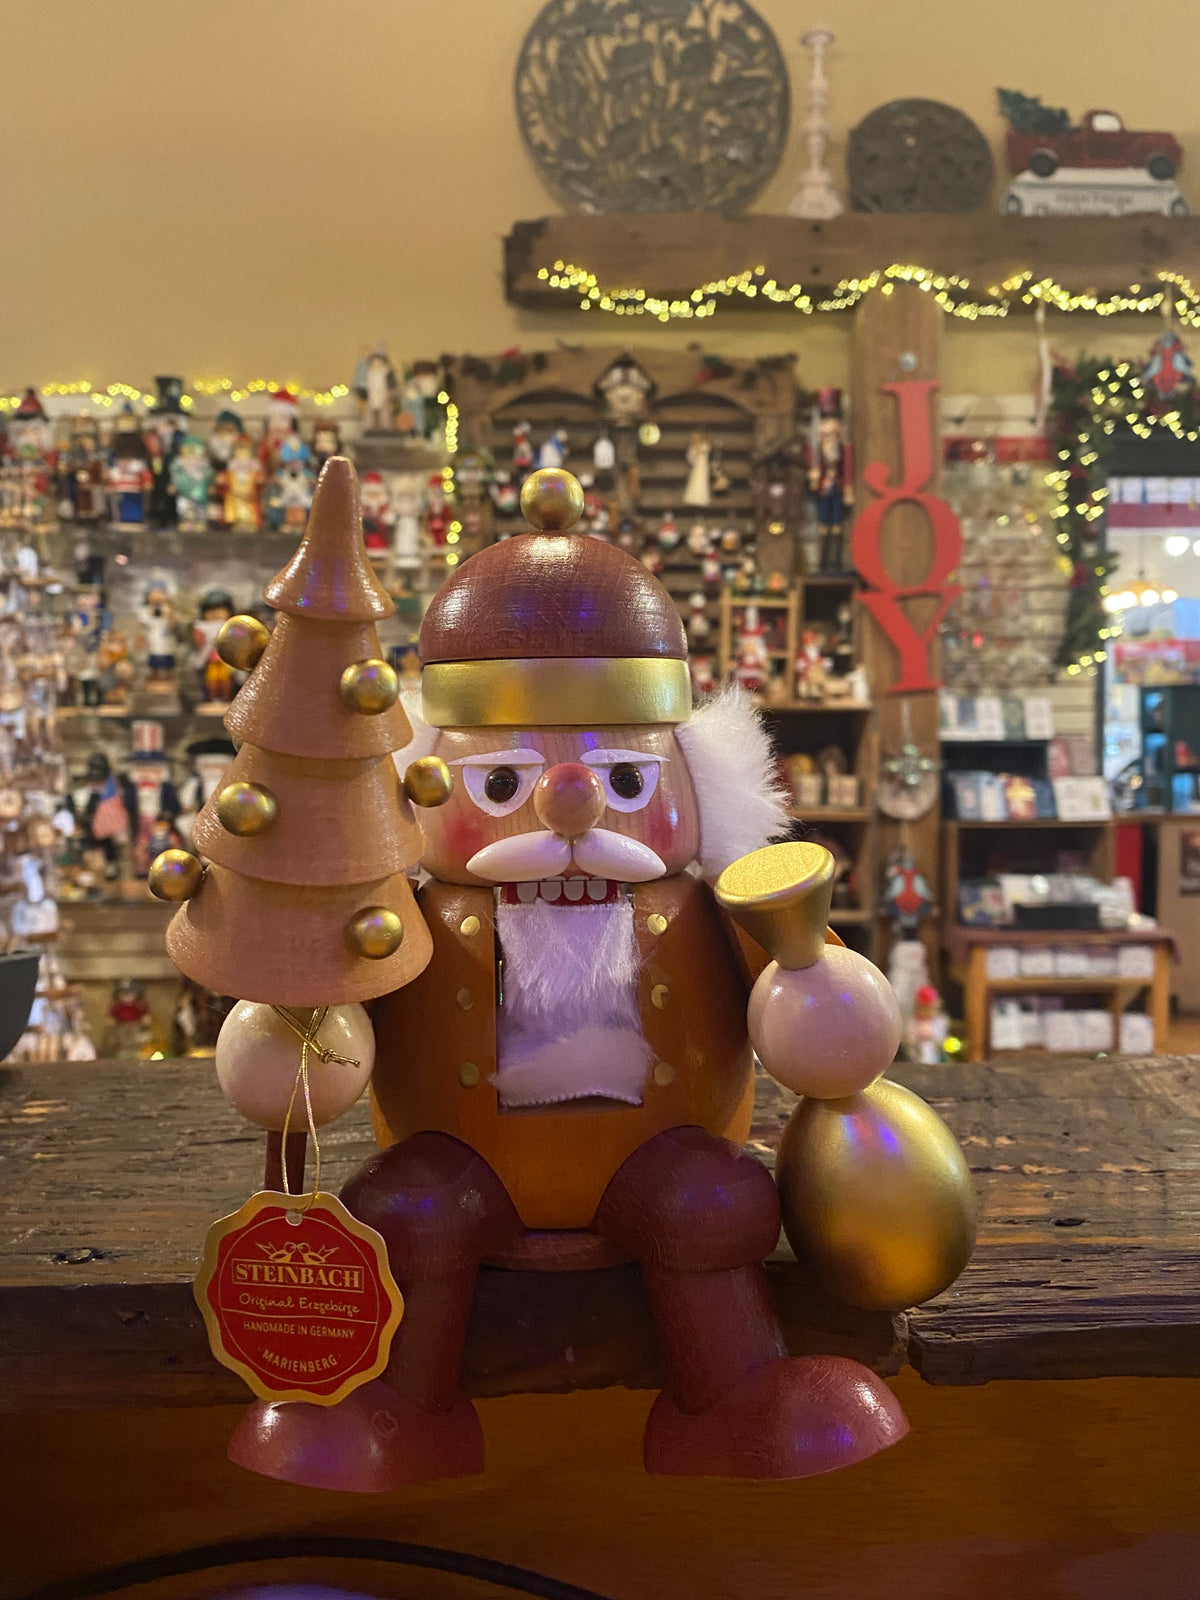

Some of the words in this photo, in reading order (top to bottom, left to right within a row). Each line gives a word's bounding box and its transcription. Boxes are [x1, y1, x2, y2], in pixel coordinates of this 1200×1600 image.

[851, 380, 964, 692] JOY
[235, 1263, 361, 1288] STEINBACH
[238, 1292, 295, 1310] Original
[299, 1298, 360, 1316] Erzgebirge
[243, 1321, 295, 1335] HANDMADE
[297, 1325, 308, 1335] IN
[309, 1325, 355, 1339] GERMANY
[262, 1349, 338, 1373] MARIENBERG
